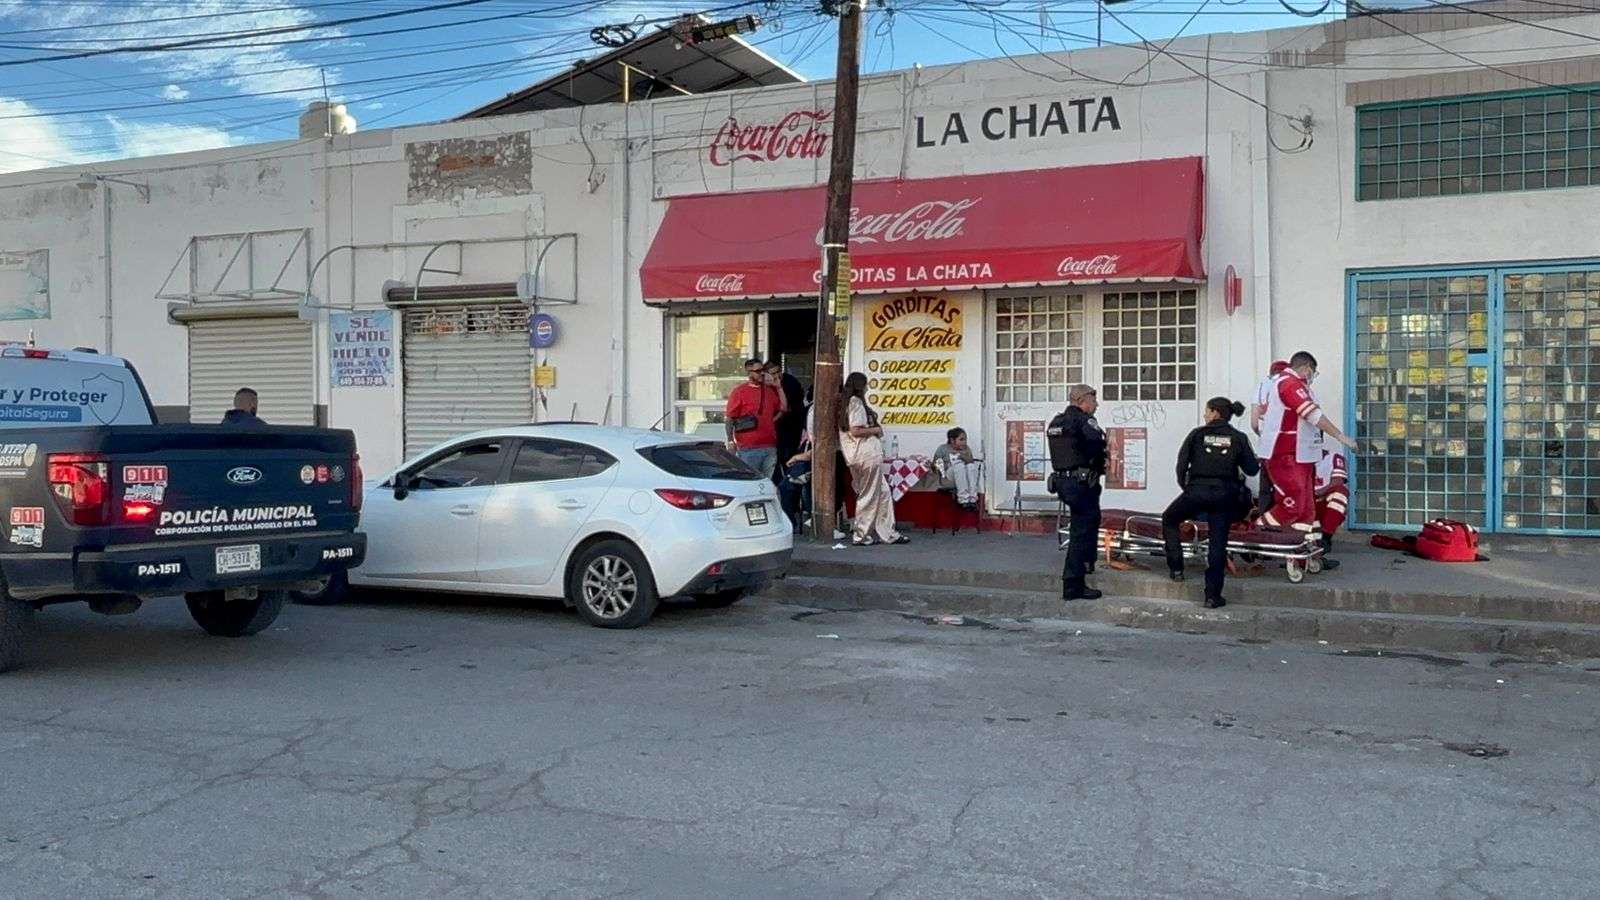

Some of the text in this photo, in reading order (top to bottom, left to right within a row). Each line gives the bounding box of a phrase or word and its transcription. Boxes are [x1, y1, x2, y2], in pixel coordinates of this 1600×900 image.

[916, 96, 1121, 148] LA CHATA
[710, 109, 834, 166] Coca-Cola
[906, 266, 928, 281] LA
[933, 263, 993, 280] CHATA
[1057, 255, 1120, 276] Coca-Cola
[695, 273, 745, 292] Coca-Cola
[872, 296, 960, 328] GORDITAS
[349, 317, 374, 329] SE
[334, 330, 391, 342] VENDE
[869, 327, 963, 352] La Chata
[880, 360, 951, 373] GORDITAS
[880, 378, 930, 391] TACOS
[13, 388, 24, 404] y
[30, 387, 107, 406] Proteger
[880, 395, 950, 407] FLAUTAS
[880, 411, 955, 425] ENCHILADAS
[126, 468, 164, 481] 911
[232, 469, 257, 481] Ford
[12, 510, 42, 523] 911
[160, 505, 315, 526] POLICÍA MUNICIPAL
[155, 525, 211, 536] CORPORACIÓN
[212, 524, 223, 532] DE
[253, 521, 282, 530] MODELO
[322, 548, 353, 560] PA-1511
[138, 562, 181, 576] PA-1511
